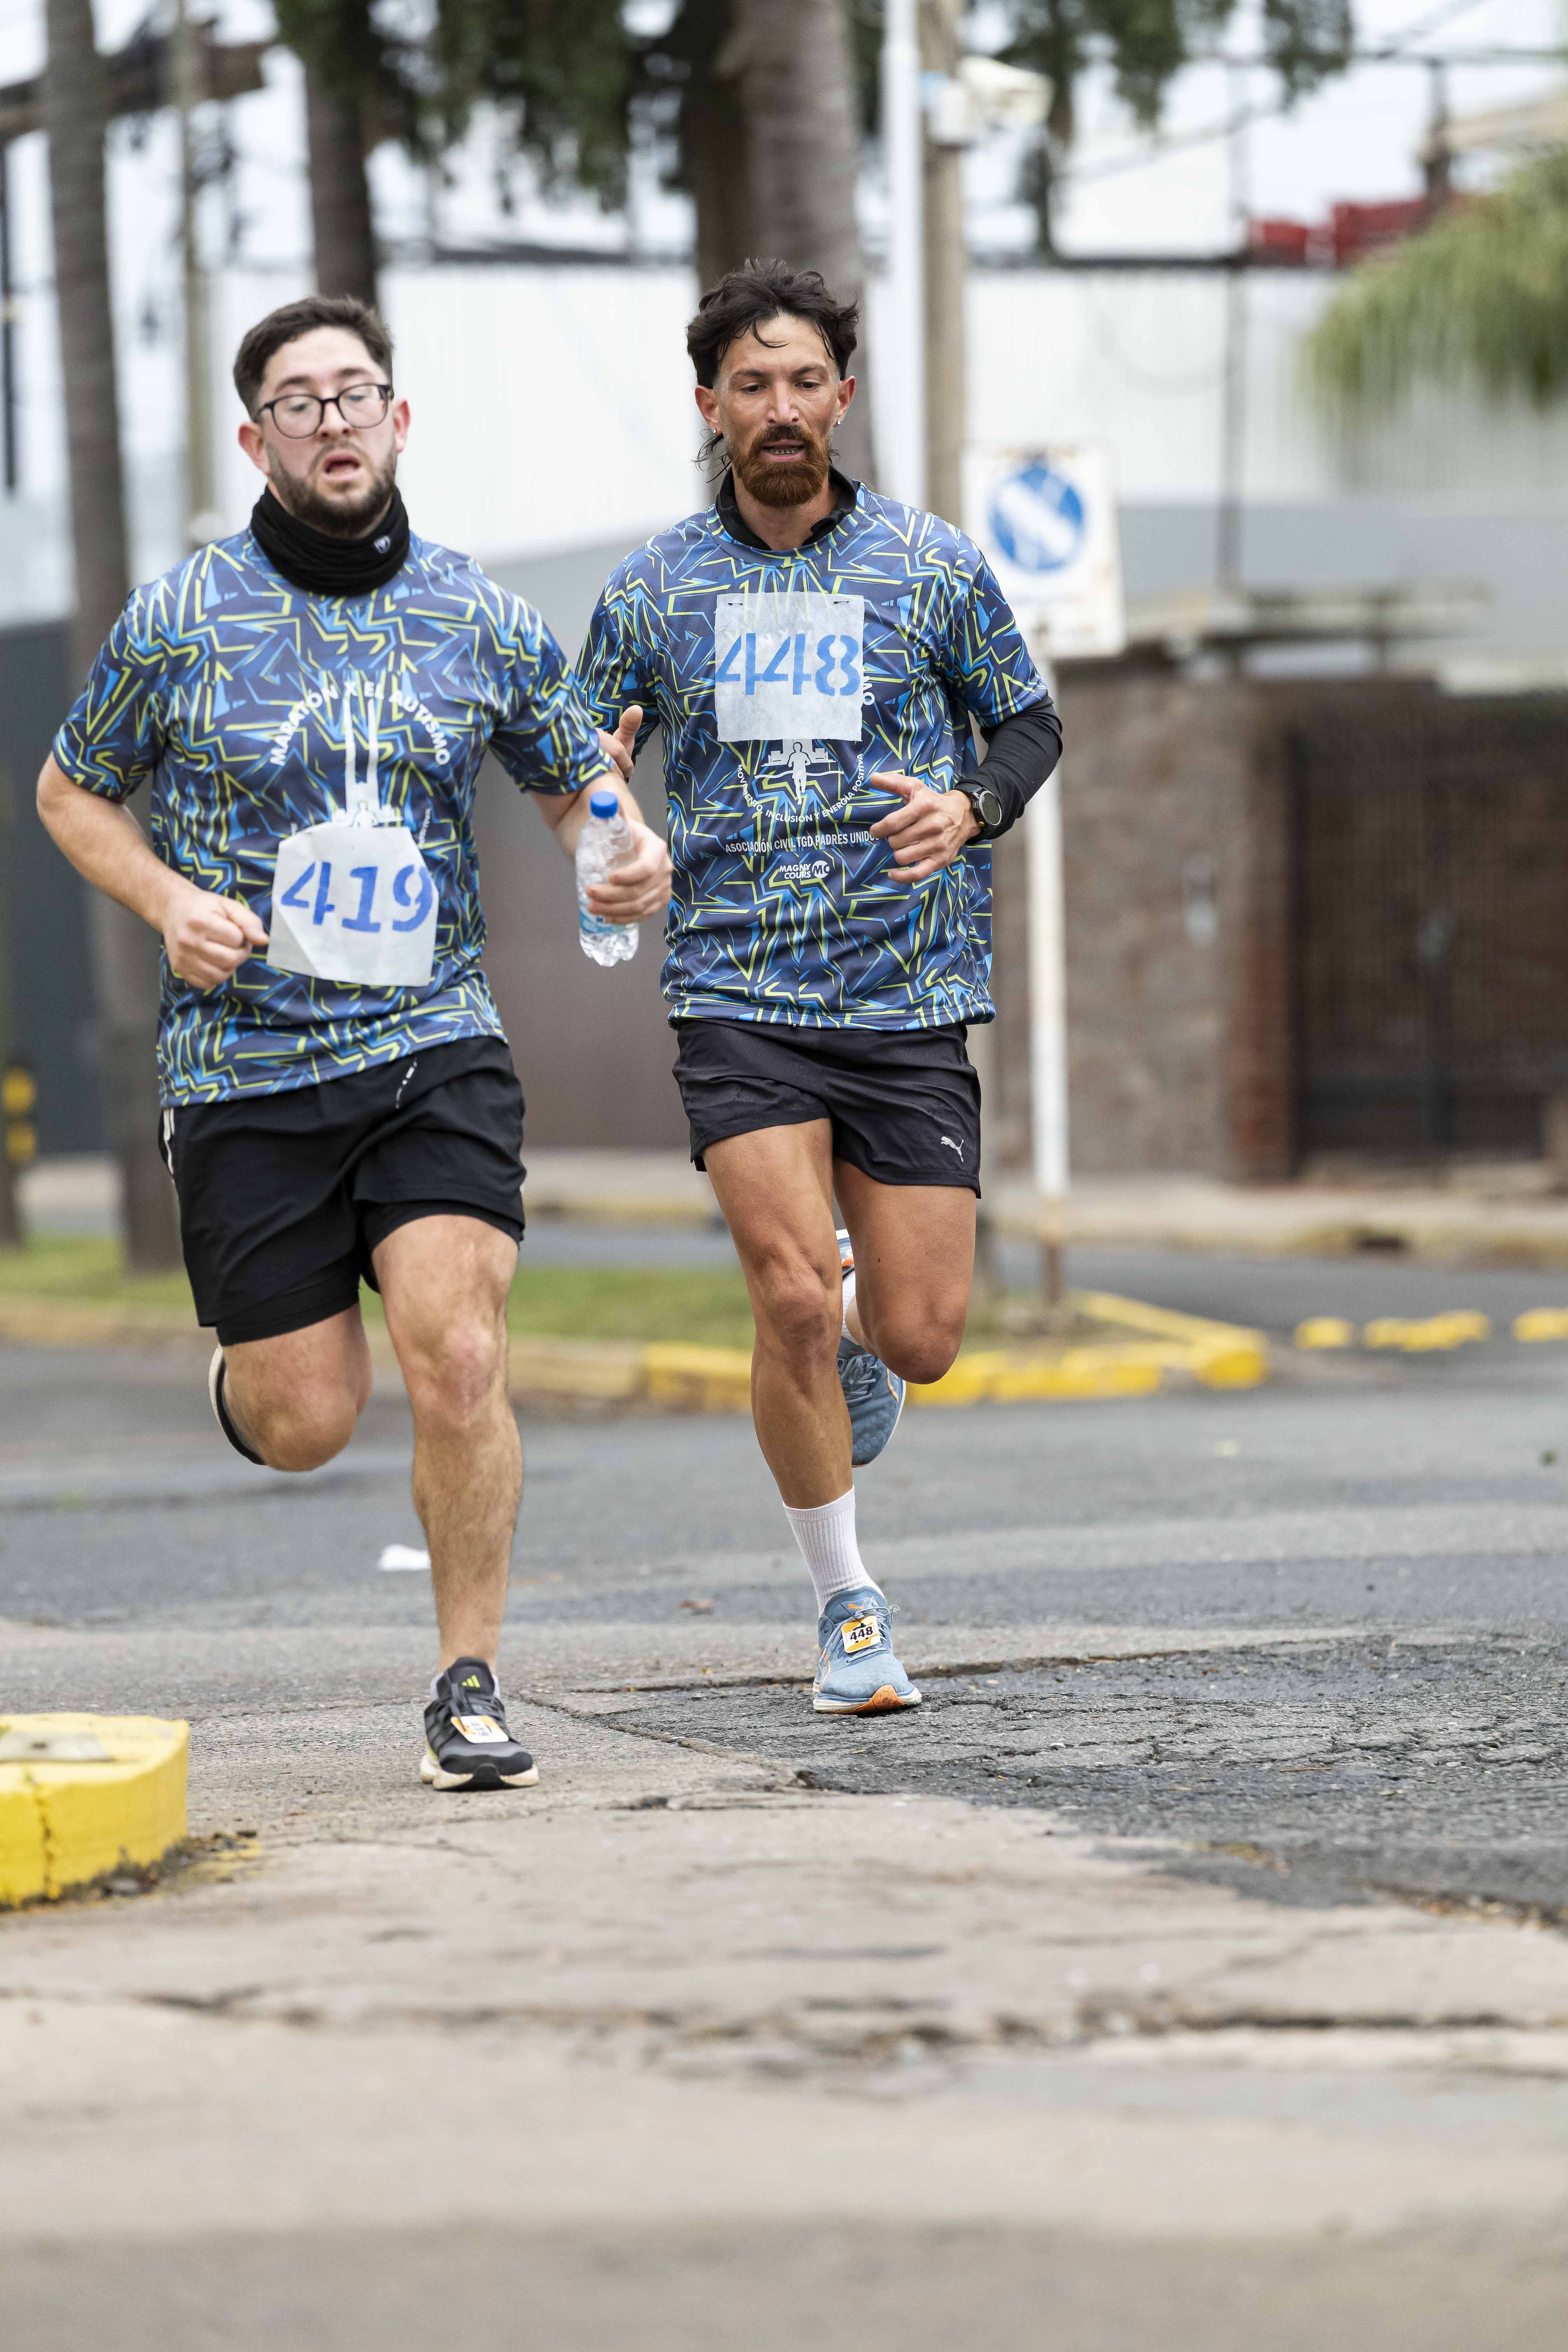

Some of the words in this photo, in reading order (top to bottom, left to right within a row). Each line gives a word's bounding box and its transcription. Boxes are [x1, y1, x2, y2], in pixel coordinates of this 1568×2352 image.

[716, 633, 861, 696] 448
[270, 684, 339, 766] MARATÓN
[364, 681, 384, 699] EL
[388, 690, 450, 765] AUTISMO
[822, 792, 855, 817] ENERGÍA
[852, 753, 864, 792] POSITIVA
[726, 838, 773, 853] ASOCIACIÓN
[774, 837, 796, 849] CIVIL
[796, 836, 814, 847] TGD
[815, 833, 849, 845] PADRES
[779, 864, 811, 872] MAGNY
[281, 862, 433, 933] 419
[850, 1626, 873, 1640] 448
